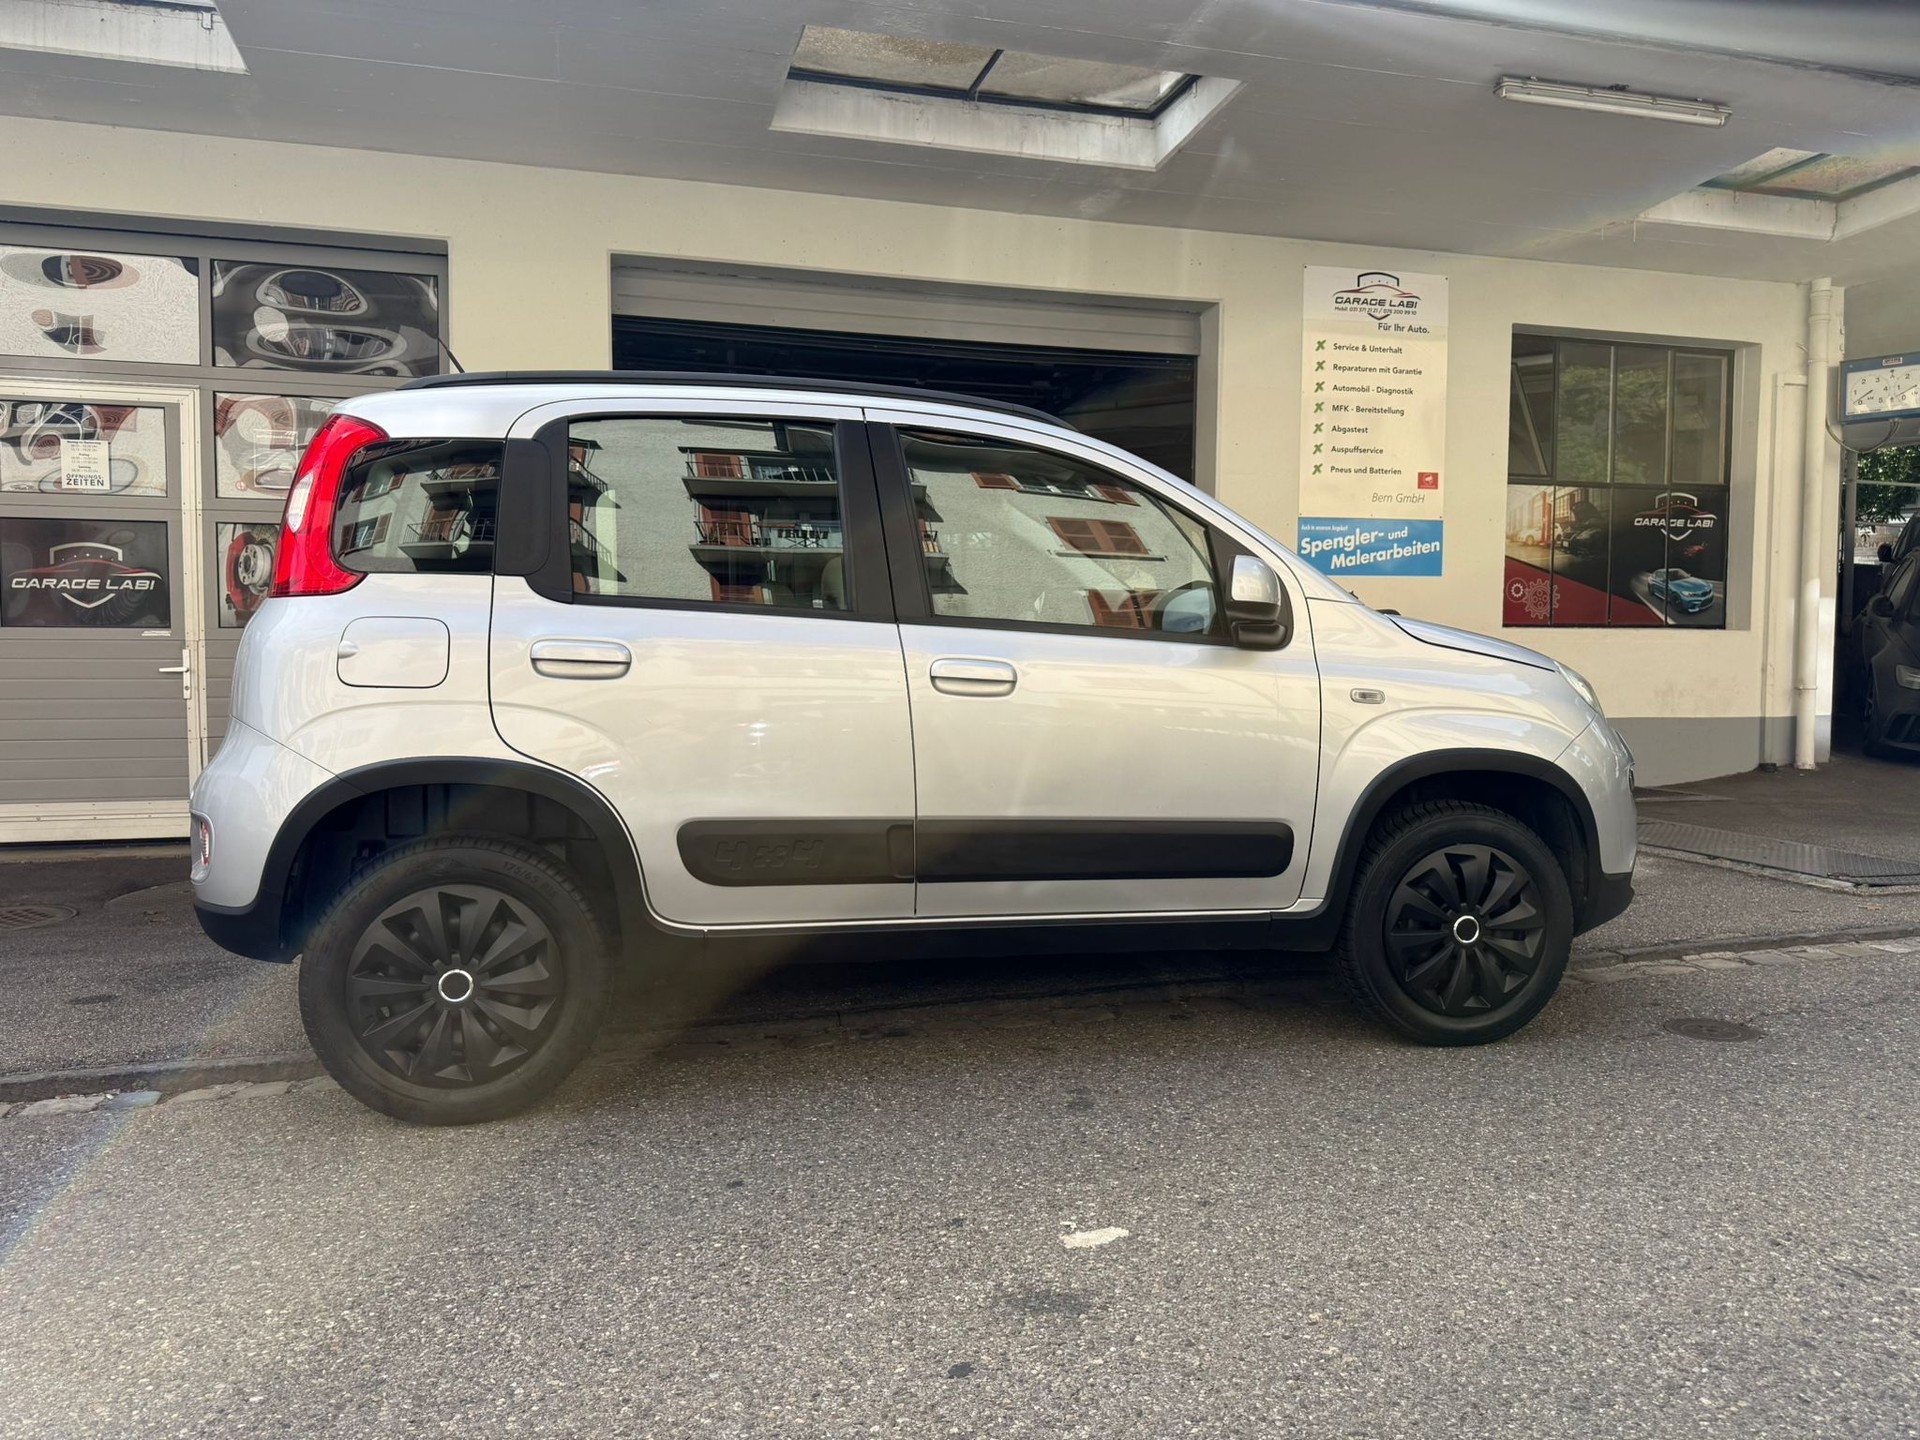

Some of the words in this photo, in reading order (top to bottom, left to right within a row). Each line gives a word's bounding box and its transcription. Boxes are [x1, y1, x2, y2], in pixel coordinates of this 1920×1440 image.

[1335, 296, 1386, 307] GARAGE
[1389, 300, 1418, 309] LABI
[1378, 322, 1391, 331] Für
[1394, 323, 1405, 332] Ihr
[1408, 325, 1430, 334] Auto.
[1333, 343, 1359, 352] Service
[1369, 345, 1403, 354] Unterhalt
[1333, 363, 1377, 374] Reparaturen
[1379, 366, 1390, 374] mit
[1393, 367, 1422, 375] Garantie
[1332, 384, 1370, 393] Automobil
[1376, 387, 1414, 396] Diagnostik
[1332, 404, 1349, 413] MFK
[1356, 406, 1405, 416] Bereitstellung
[1331, 425, 1368, 434] Abgastest
[1331, 445, 1384, 454] Auspuffservice
[1330, 466, 1352, 474] Pneus
[1369, 467, 1402, 475] Batterien
[66, 478, 104, 486] ZEITEN
[1371, 492, 1393, 503] Bern
[1396, 493, 1426, 504] GmbH
[1634, 516, 1685, 528] GARAGE
[1687, 517, 1714, 528] LABI
[1300, 528, 1384, 558] Spengler-
[1388, 526, 1409, 540] und
[1330, 540, 1440, 569] Malerarbeiten
[11, 577, 100, 590] GARAGE
[105, 578, 156, 591] LABI
